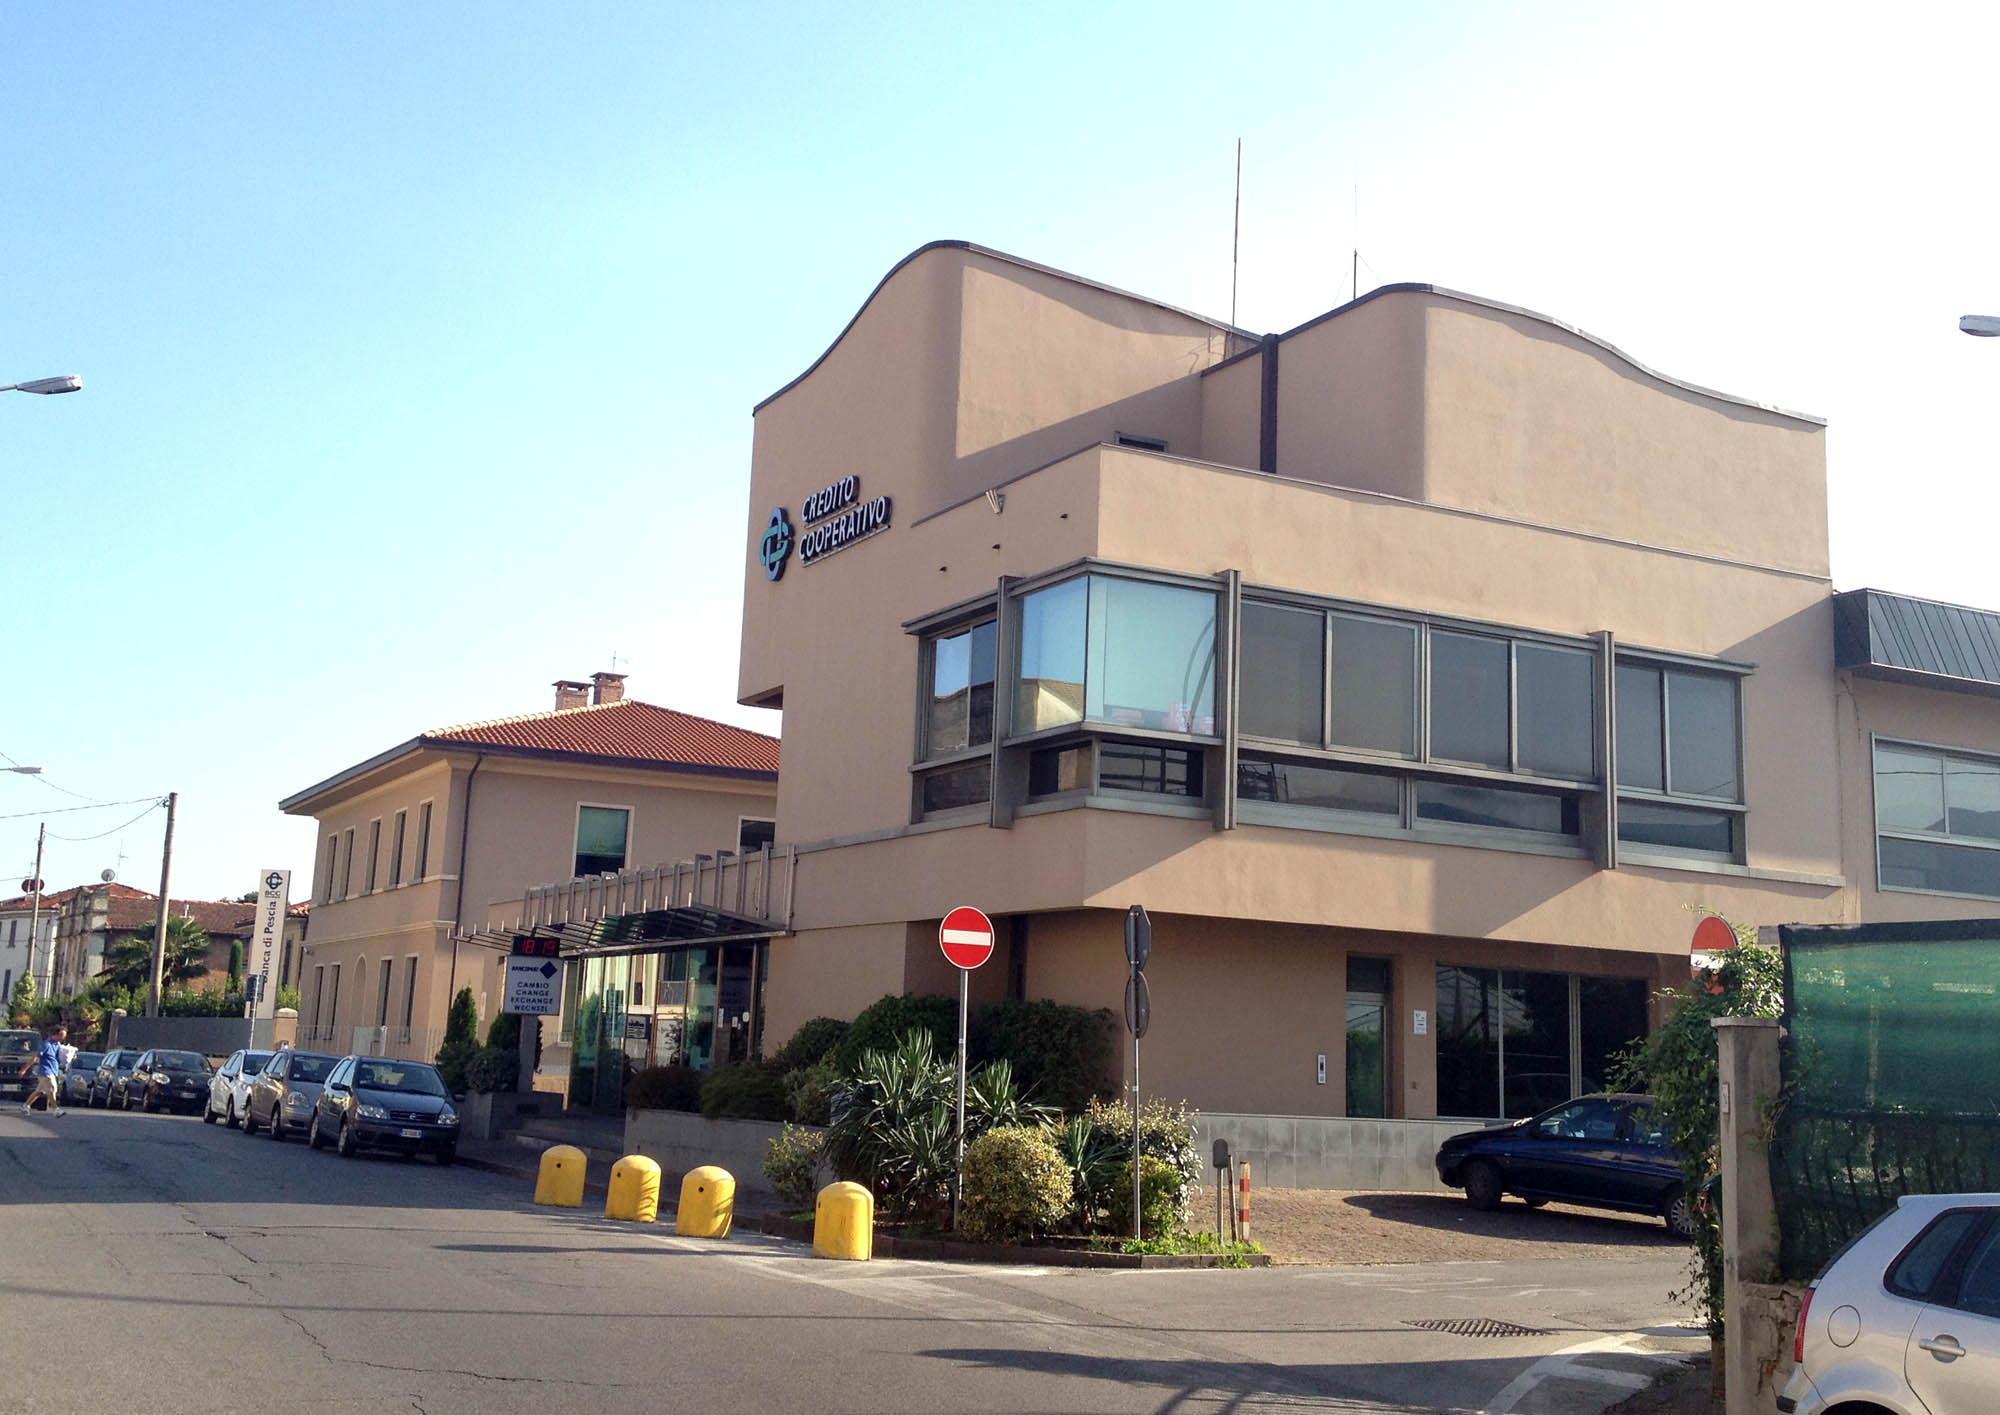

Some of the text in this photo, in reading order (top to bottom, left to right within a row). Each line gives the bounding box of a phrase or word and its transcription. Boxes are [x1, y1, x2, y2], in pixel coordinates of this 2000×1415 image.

[802, 475, 857, 522] CREDITO
[799, 496, 888, 560] COOPERATIVO
[264, 901, 277, 934] Pescia
[263, 937, 273, 948] di
[510, 997, 553, 1005] EXCHANGE
[516, 989, 549, 997] CHANGE
